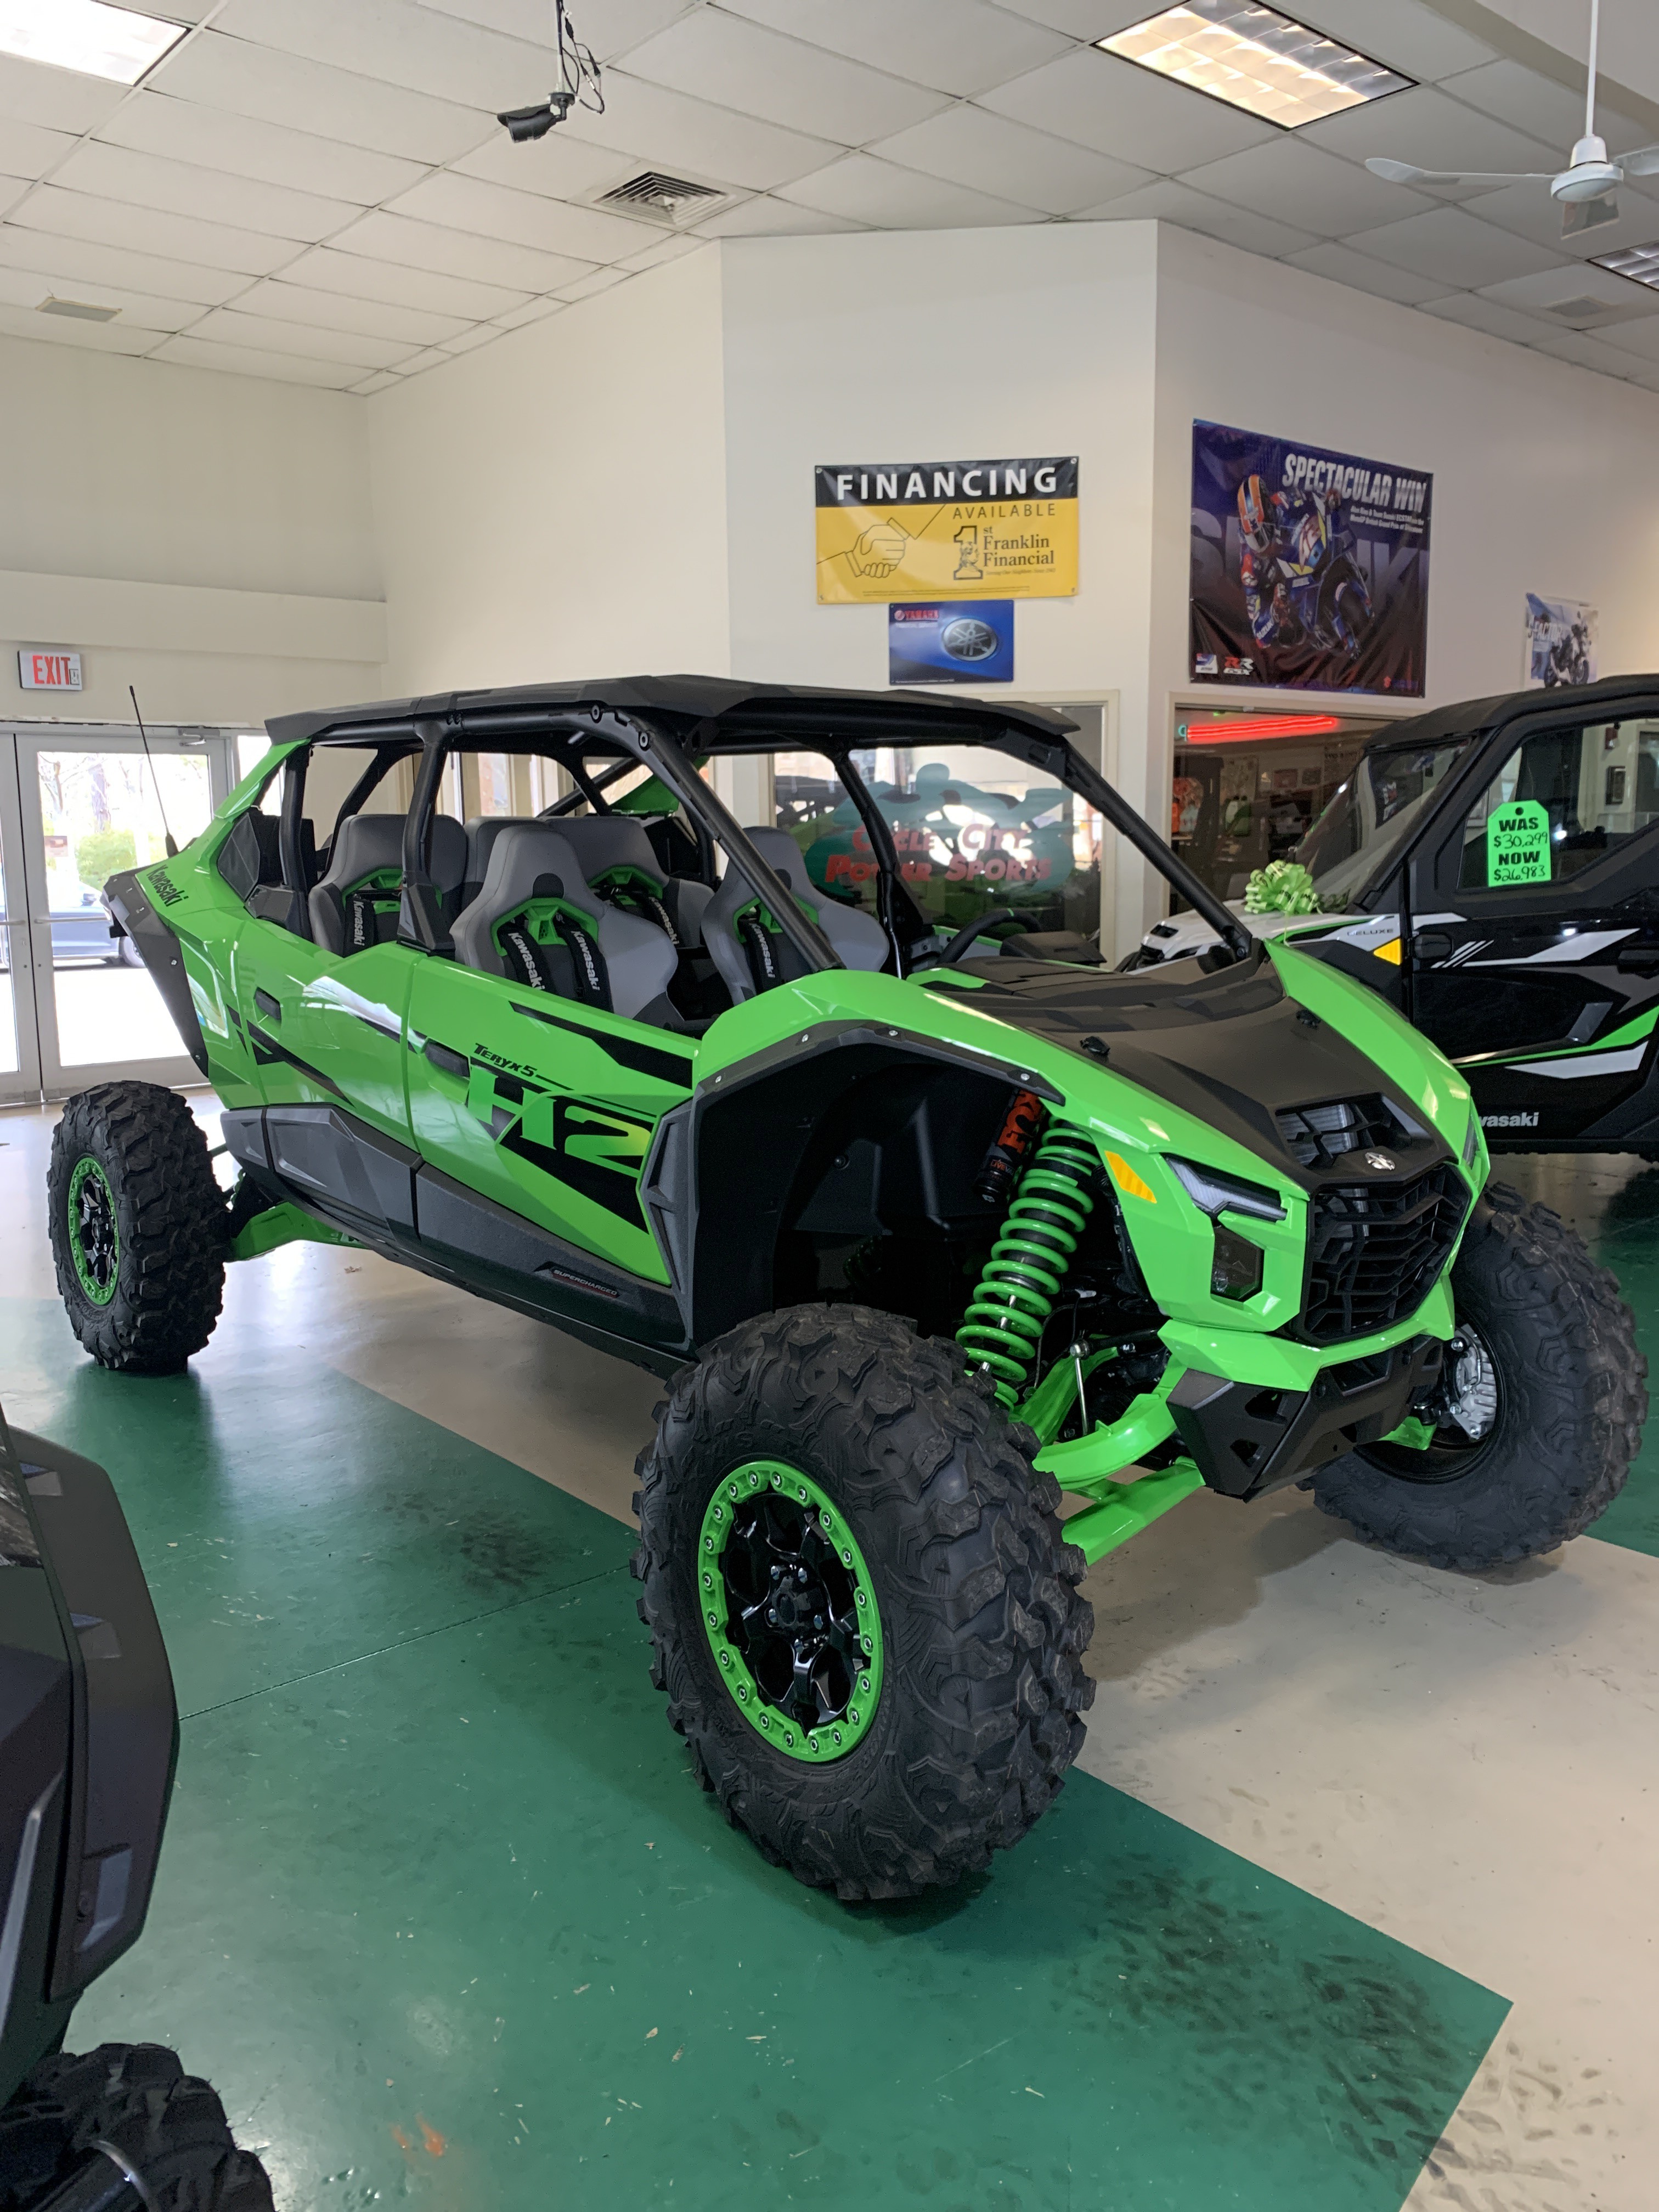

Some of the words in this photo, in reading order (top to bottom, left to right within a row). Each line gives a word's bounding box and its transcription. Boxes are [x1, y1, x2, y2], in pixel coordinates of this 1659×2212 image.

[837, 467, 1057, 500] FINANCING
[1282, 453, 1392, 506] SPECTACULAR
[1394, 478, 1427, 513] WIN
[953, 503, 1056, 520] AVAILABLE
[983, 534, 1049, 550] Franklin
[983, 550, 1054, 567] Financial
[32, 655, 71, 685] EXIT
[853, 825, 937, 851] CCLE
[1499, 817, 1539, 832] WAS
[825, 854, 932, 883] POER
[1499, 851, 1541, 866] NOW
[146, 865, 189, 907] Kawasaki
[353, 900, 365, 946] Kawasaki
[508, 932, 545, 990] Kawasaki
[571, 930, 600, 991] Kawasaki
[553, 1269, 618, 1296] SUPERCHARGED
